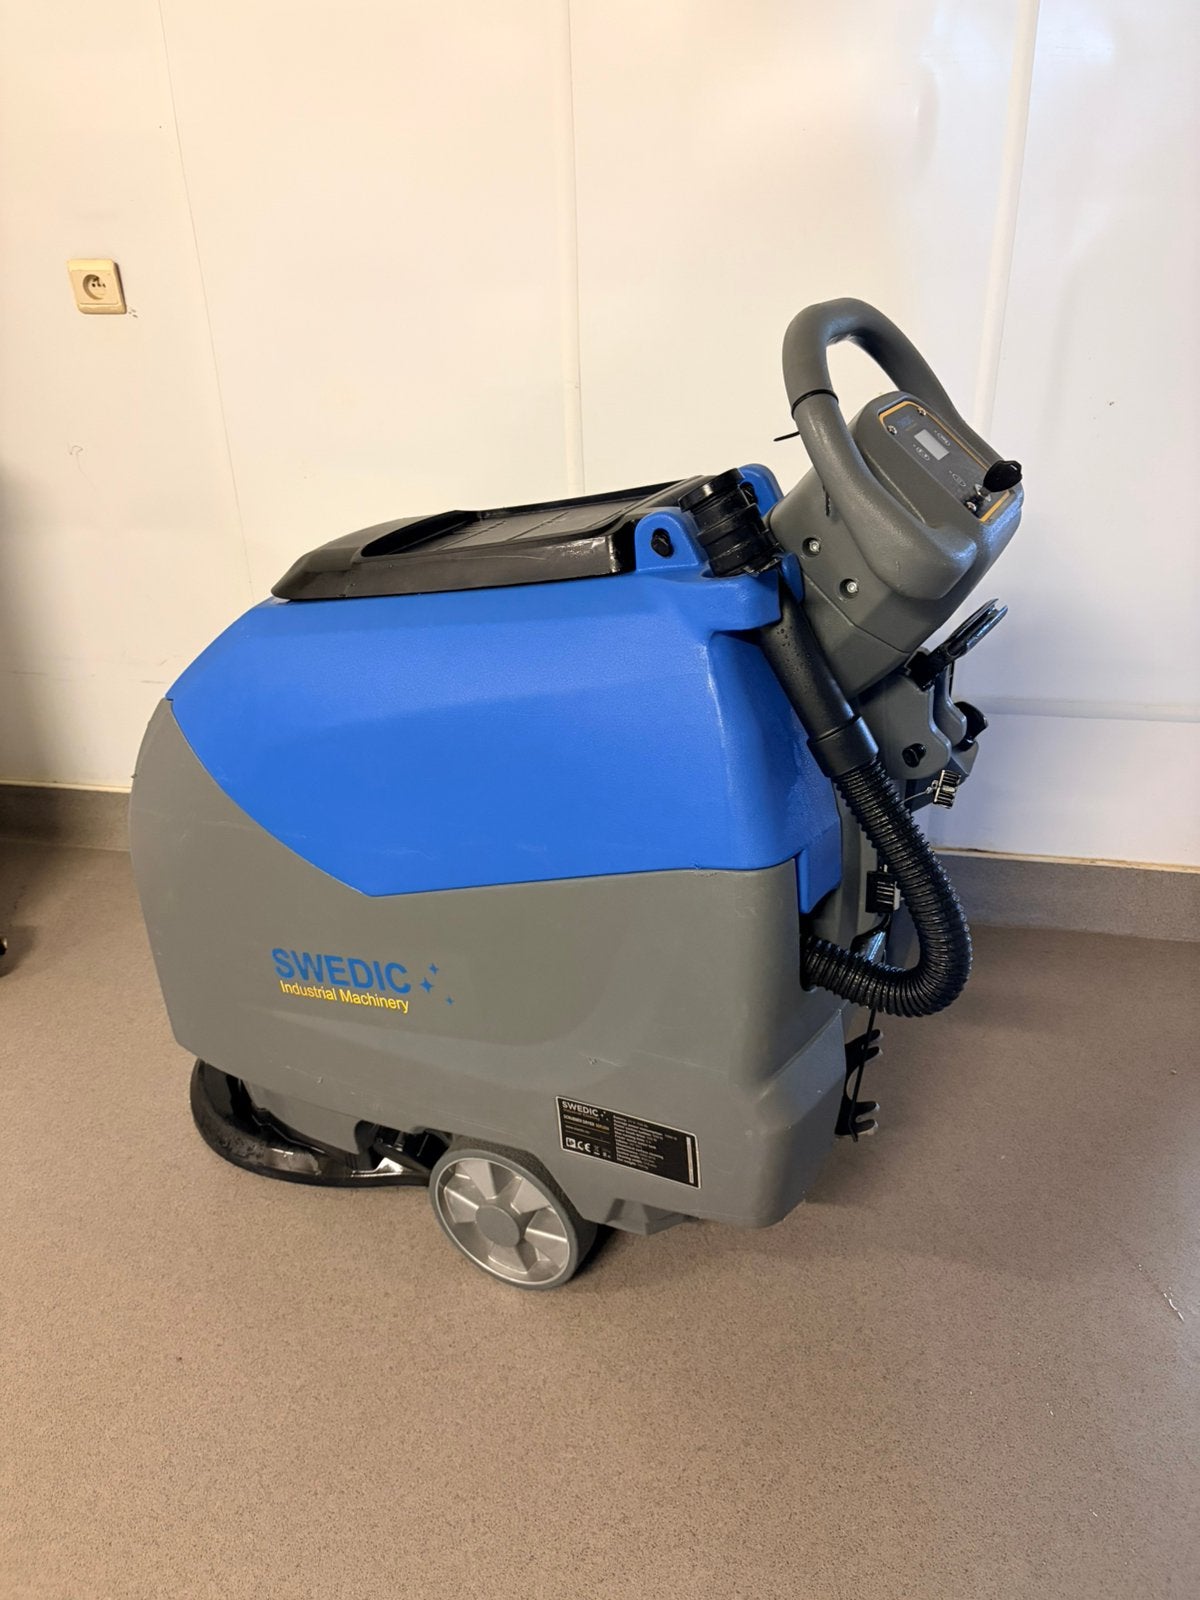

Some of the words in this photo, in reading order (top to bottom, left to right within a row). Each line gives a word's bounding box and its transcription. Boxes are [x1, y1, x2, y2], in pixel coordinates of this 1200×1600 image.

[271, 948, 411, 994] SWEDIC
[279, 980, 338, 1001] Industrial
[339, 988, 409, 1014] Machinery
[562, 1101, 599, 1117] SWEDIC
